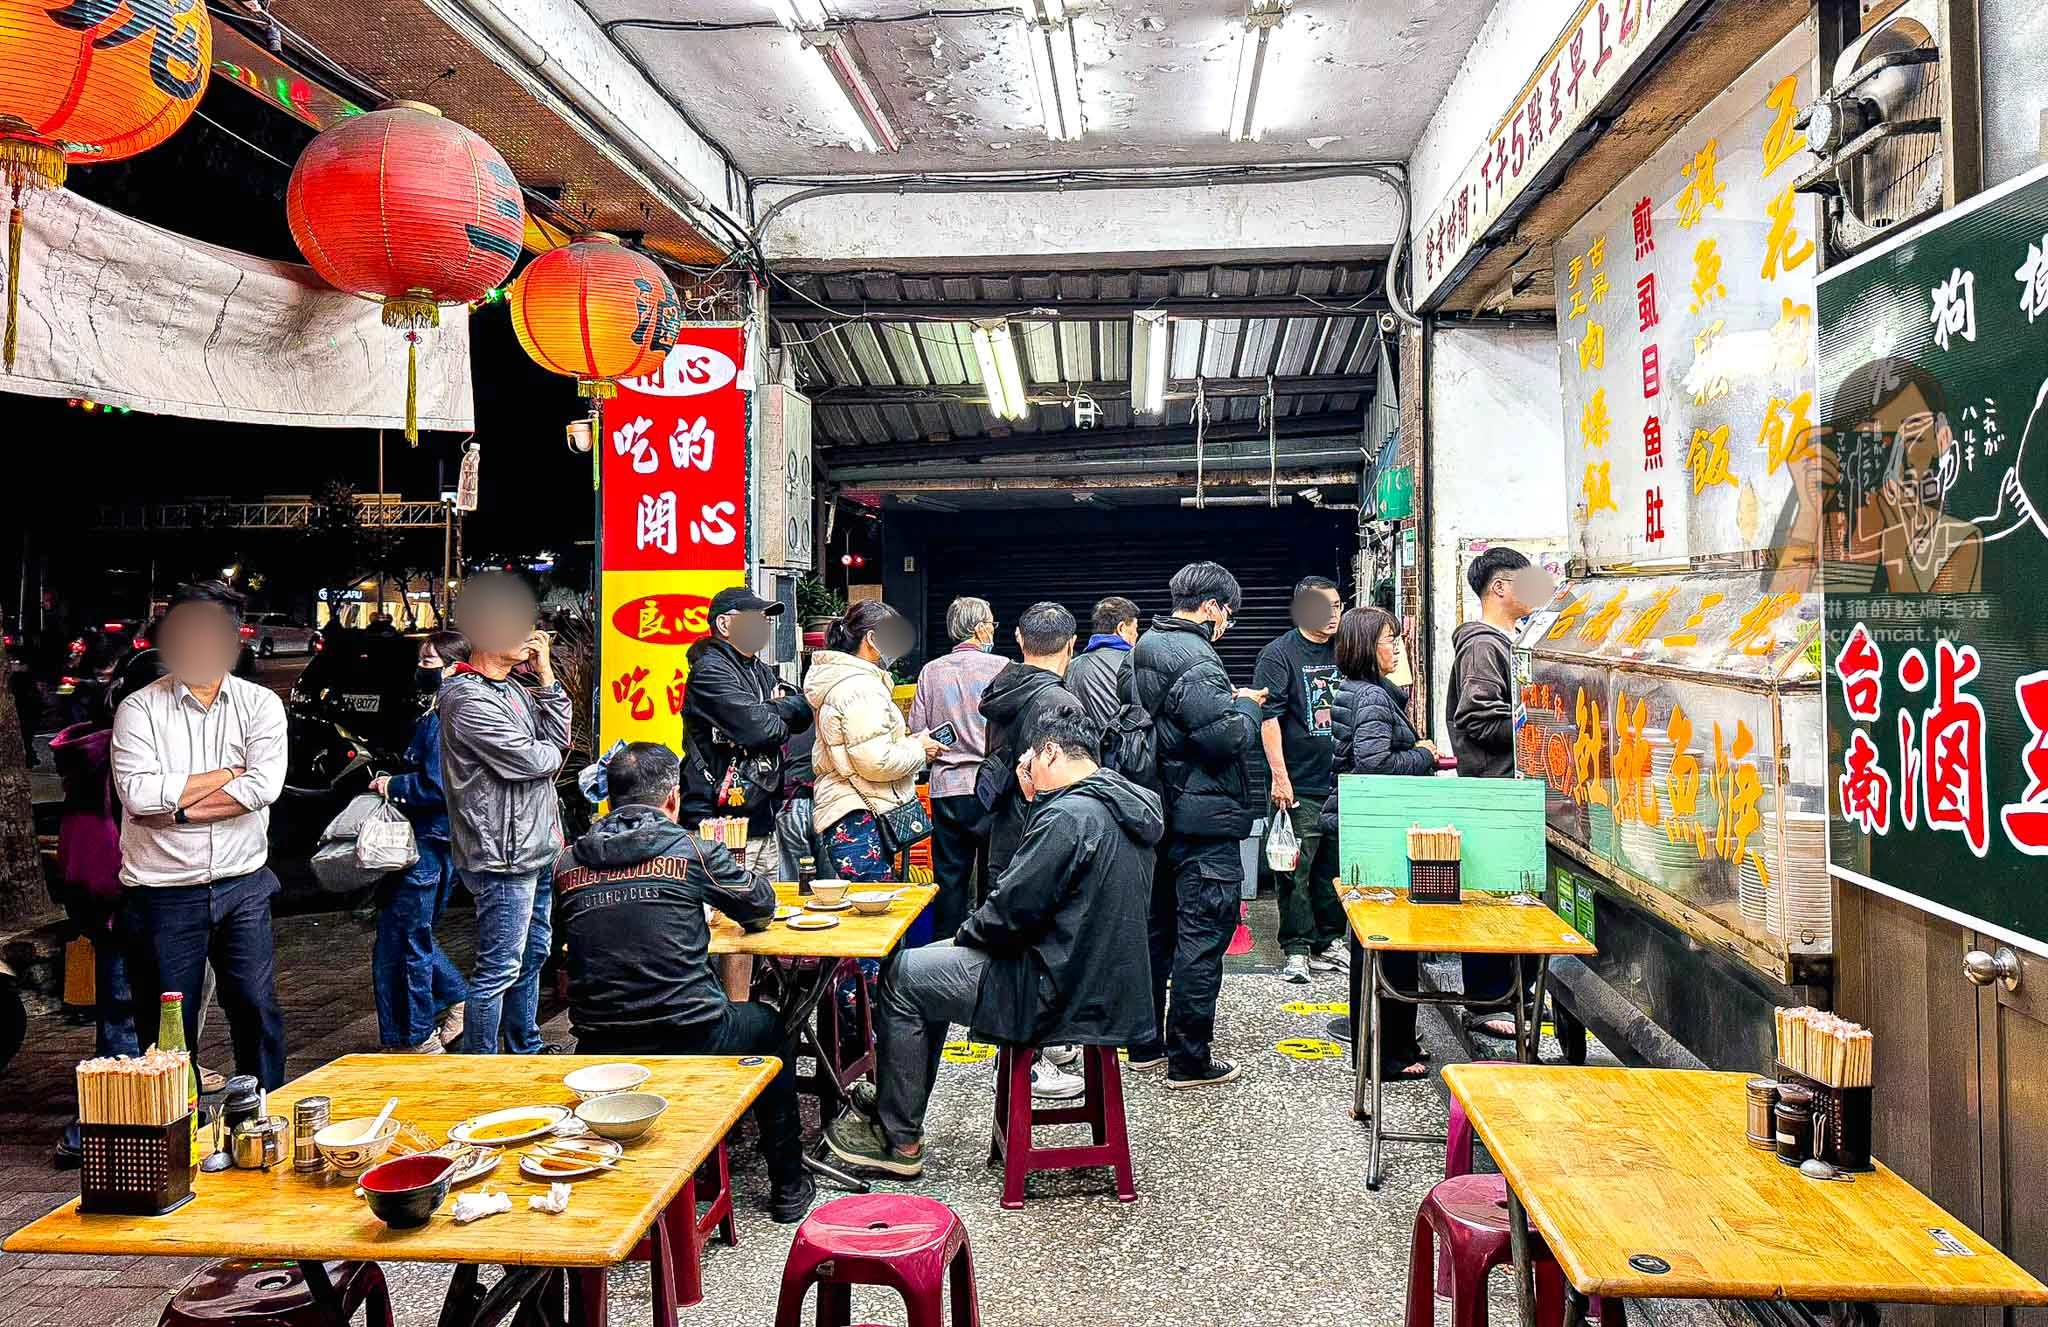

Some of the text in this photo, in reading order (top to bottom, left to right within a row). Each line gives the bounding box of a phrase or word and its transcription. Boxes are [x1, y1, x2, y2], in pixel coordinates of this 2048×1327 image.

[1632, 195, 1665, 544] 煎虱目魚肚
[613, 415, 715, 474] 吃的
[636, 489, 736, 555] 開心
[637, 599, 711, 639] 良心
[1836, 622, 1891, 836] 台南
